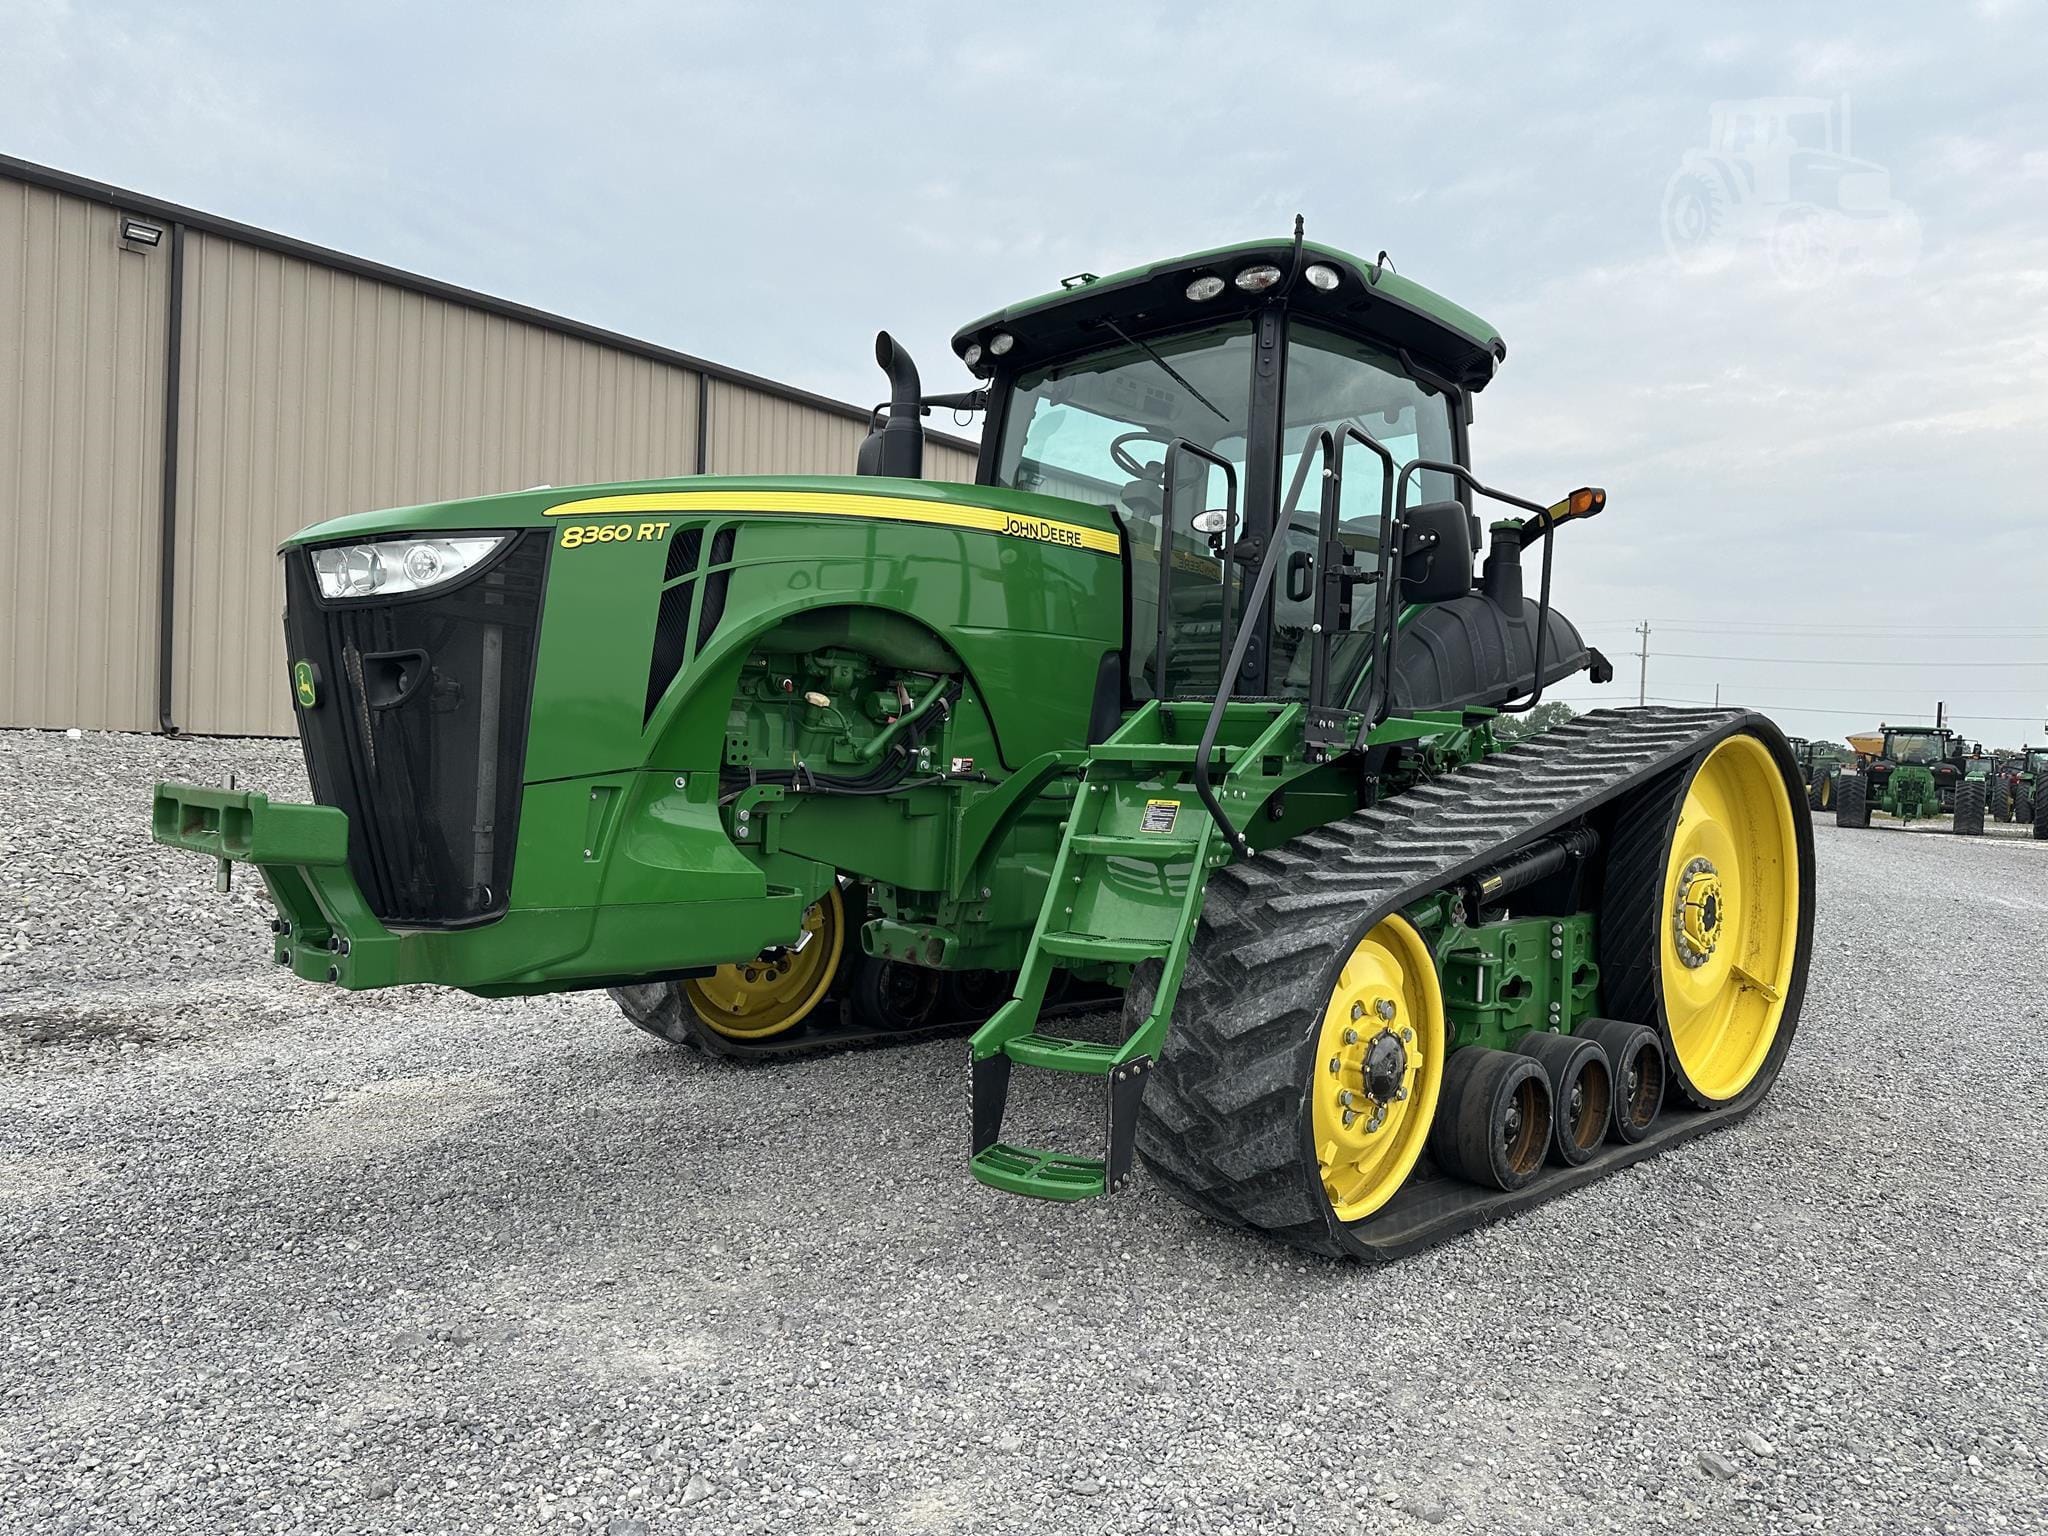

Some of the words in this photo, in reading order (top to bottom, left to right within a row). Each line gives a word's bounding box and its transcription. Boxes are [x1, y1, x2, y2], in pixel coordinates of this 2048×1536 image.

[560, 523, 633, 549] 8360
[637, 522, 671, 541] RT
[1002, 516, 1038, 537] JOHN
[1040, 522, 1081, 545] DEERE
